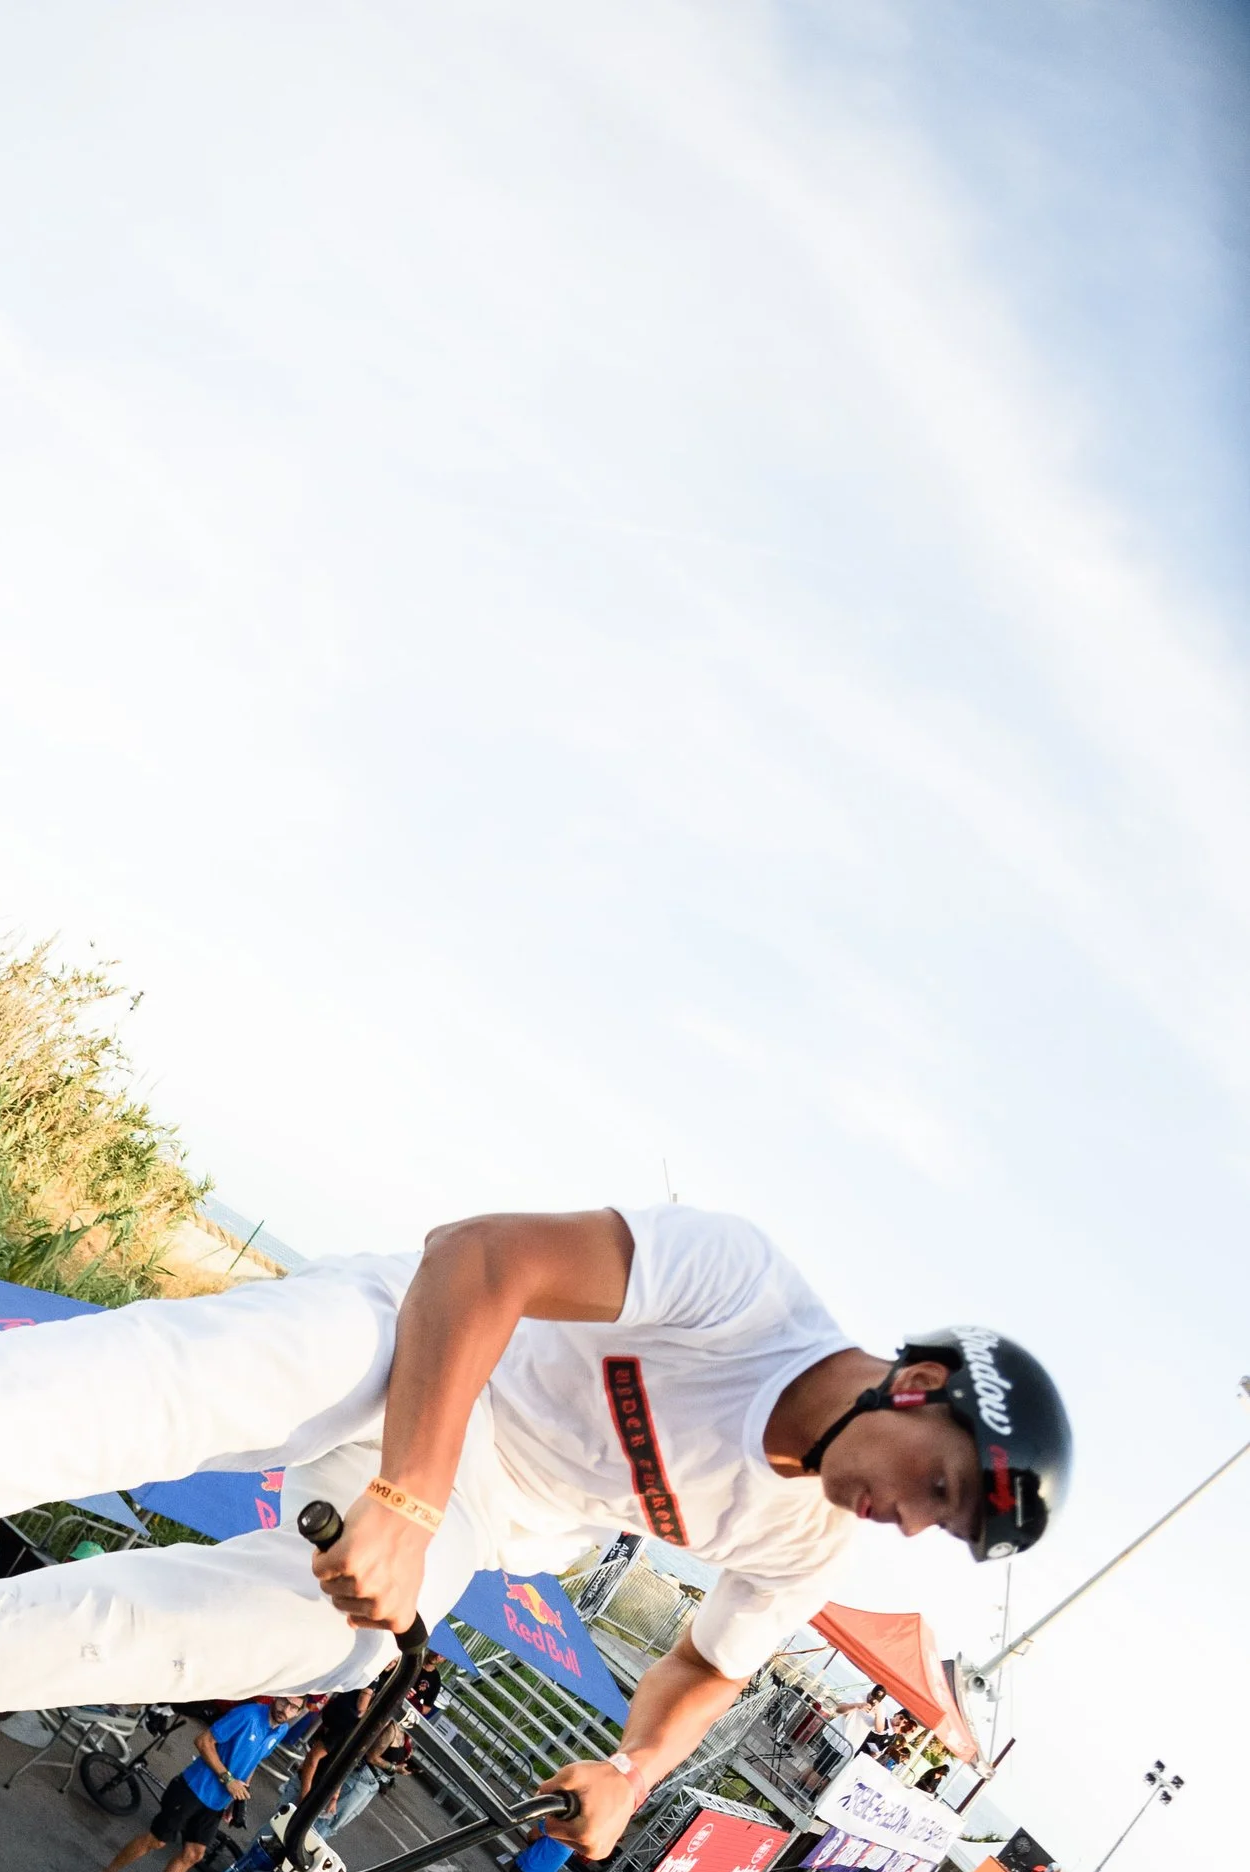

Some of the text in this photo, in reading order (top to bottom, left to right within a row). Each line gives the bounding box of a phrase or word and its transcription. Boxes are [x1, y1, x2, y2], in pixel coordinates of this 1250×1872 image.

[950, 1326, 1013, 1436] Shadow
[369, 1481, 391, 1499] BAR
[503, 1603, 582, 1678] Red Bull
